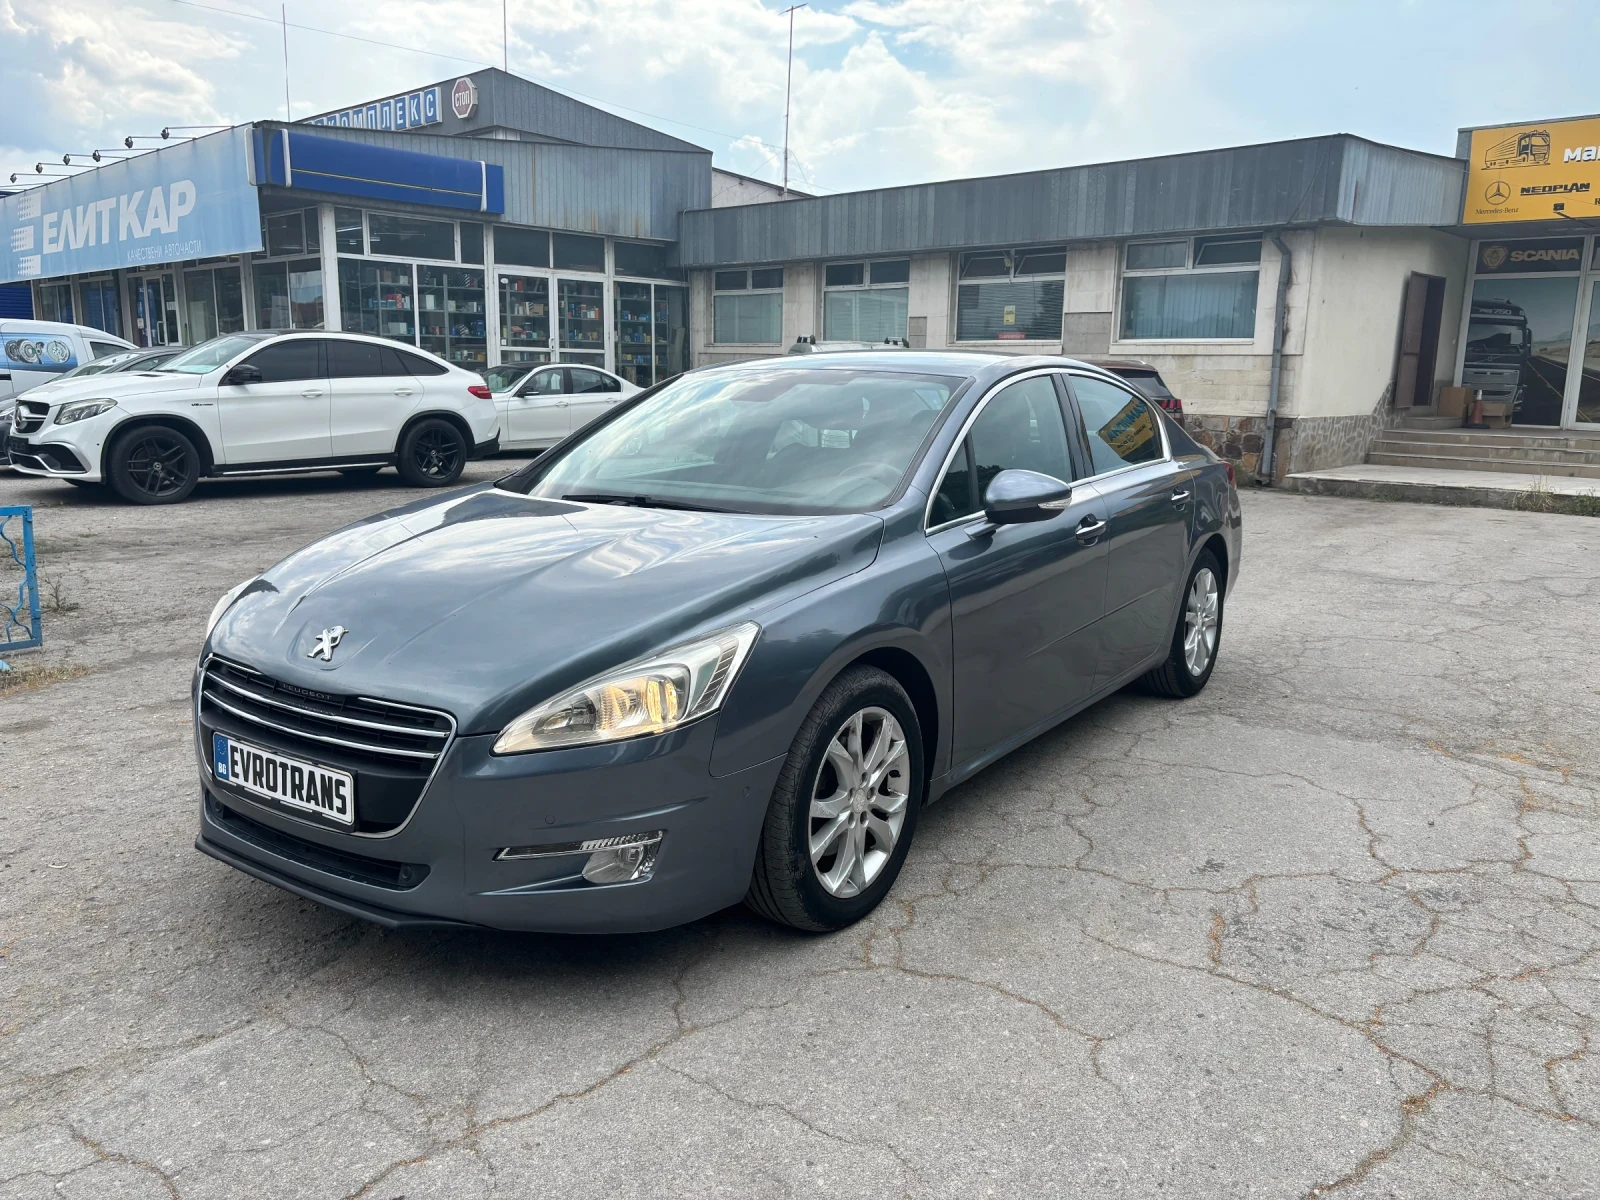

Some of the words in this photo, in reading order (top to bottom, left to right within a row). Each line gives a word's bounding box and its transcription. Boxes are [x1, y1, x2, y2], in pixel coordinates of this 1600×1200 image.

[455, 90, 470, 107] СТОП
[1520, 182, 1591, 195] NEOPLAN
[1475, 207, 1519, 215] Mercedes-Benz
[127, 245, 163, 261] КАЧЕСТВЕНИ
[164, 239, 203, 257] АВТОЧАСТИ
[1509, 248, 1580, 262] SCANIA
[283, 683, 332, 700] PEUGEOT
[218, 762, 227, 775] BG
[230, 742, 347, 816] EVROTRANS
